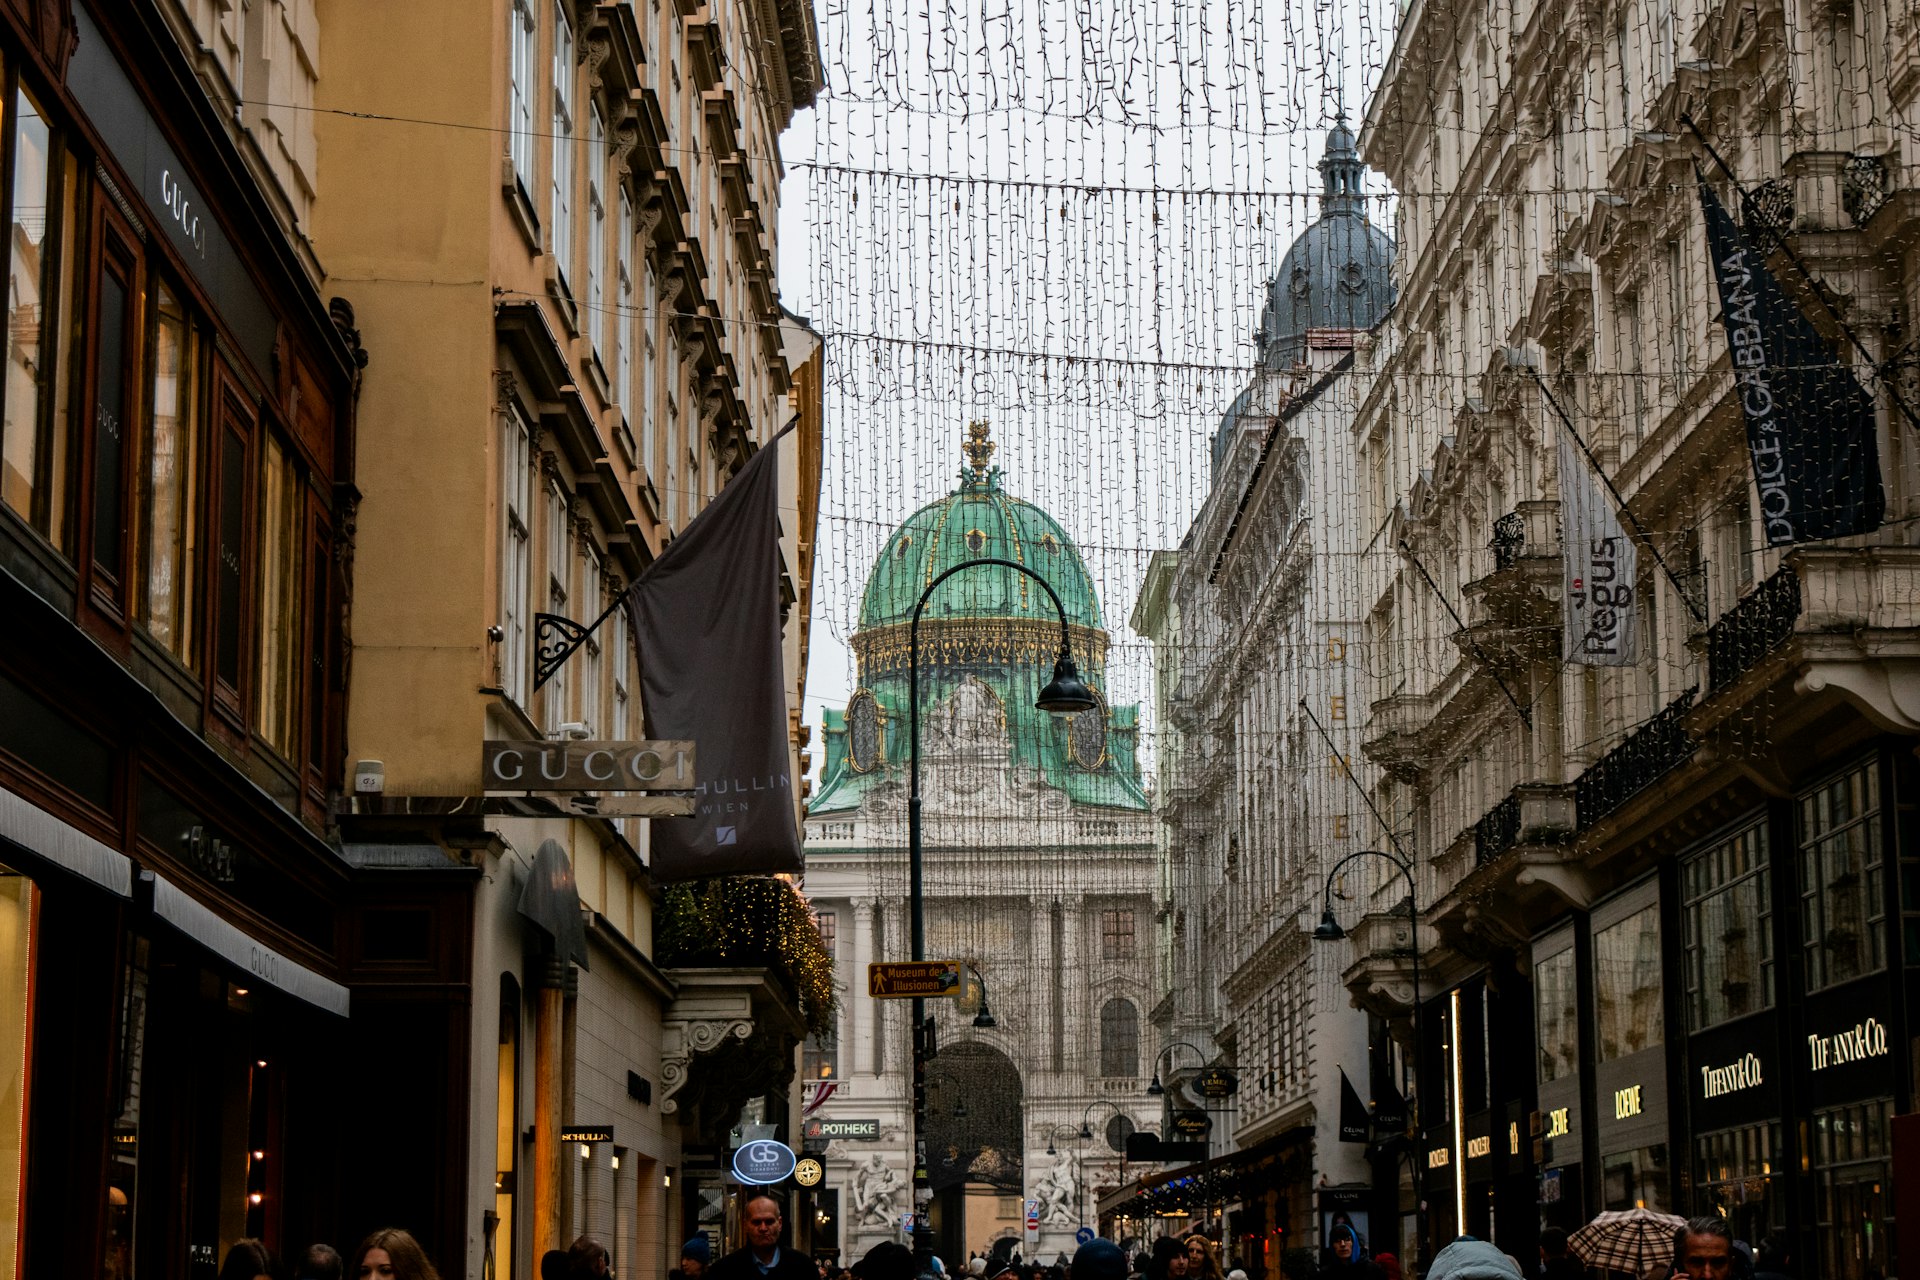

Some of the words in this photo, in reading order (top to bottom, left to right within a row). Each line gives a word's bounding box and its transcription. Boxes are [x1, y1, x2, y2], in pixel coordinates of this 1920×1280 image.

[162, 170, 206, 260] GUCCI
[1721, 248, 1774, 418] GABBANA
[1760, 420, 1777, 435] &
[1751, 437, 1795, 543] DOLCE
[1583, 539, 1633, 655] Regus
[493, 749, 685, 781] GUCCI
[1329, 637, 1354, 901] DEMEL
[655, 774, 790, 797] HULLIN
[701, 802, 750, 815] WIEN
[251, 946, 279, 984] GUCCI
[888, 967, 926, 978] Museum
[929, 967, 944, 977] der
[893, 980, 940, 991] Illusionen
[1614, 1084, 1642, 1120] LOEWE
[561, 1133, 611, 1141] SCHULLIN
[808, 1122, 876, 1136] APOTHEKE
[1546, 1107, 1569, 1138] OEWE
[750, 1143, 780, 1163] GS
